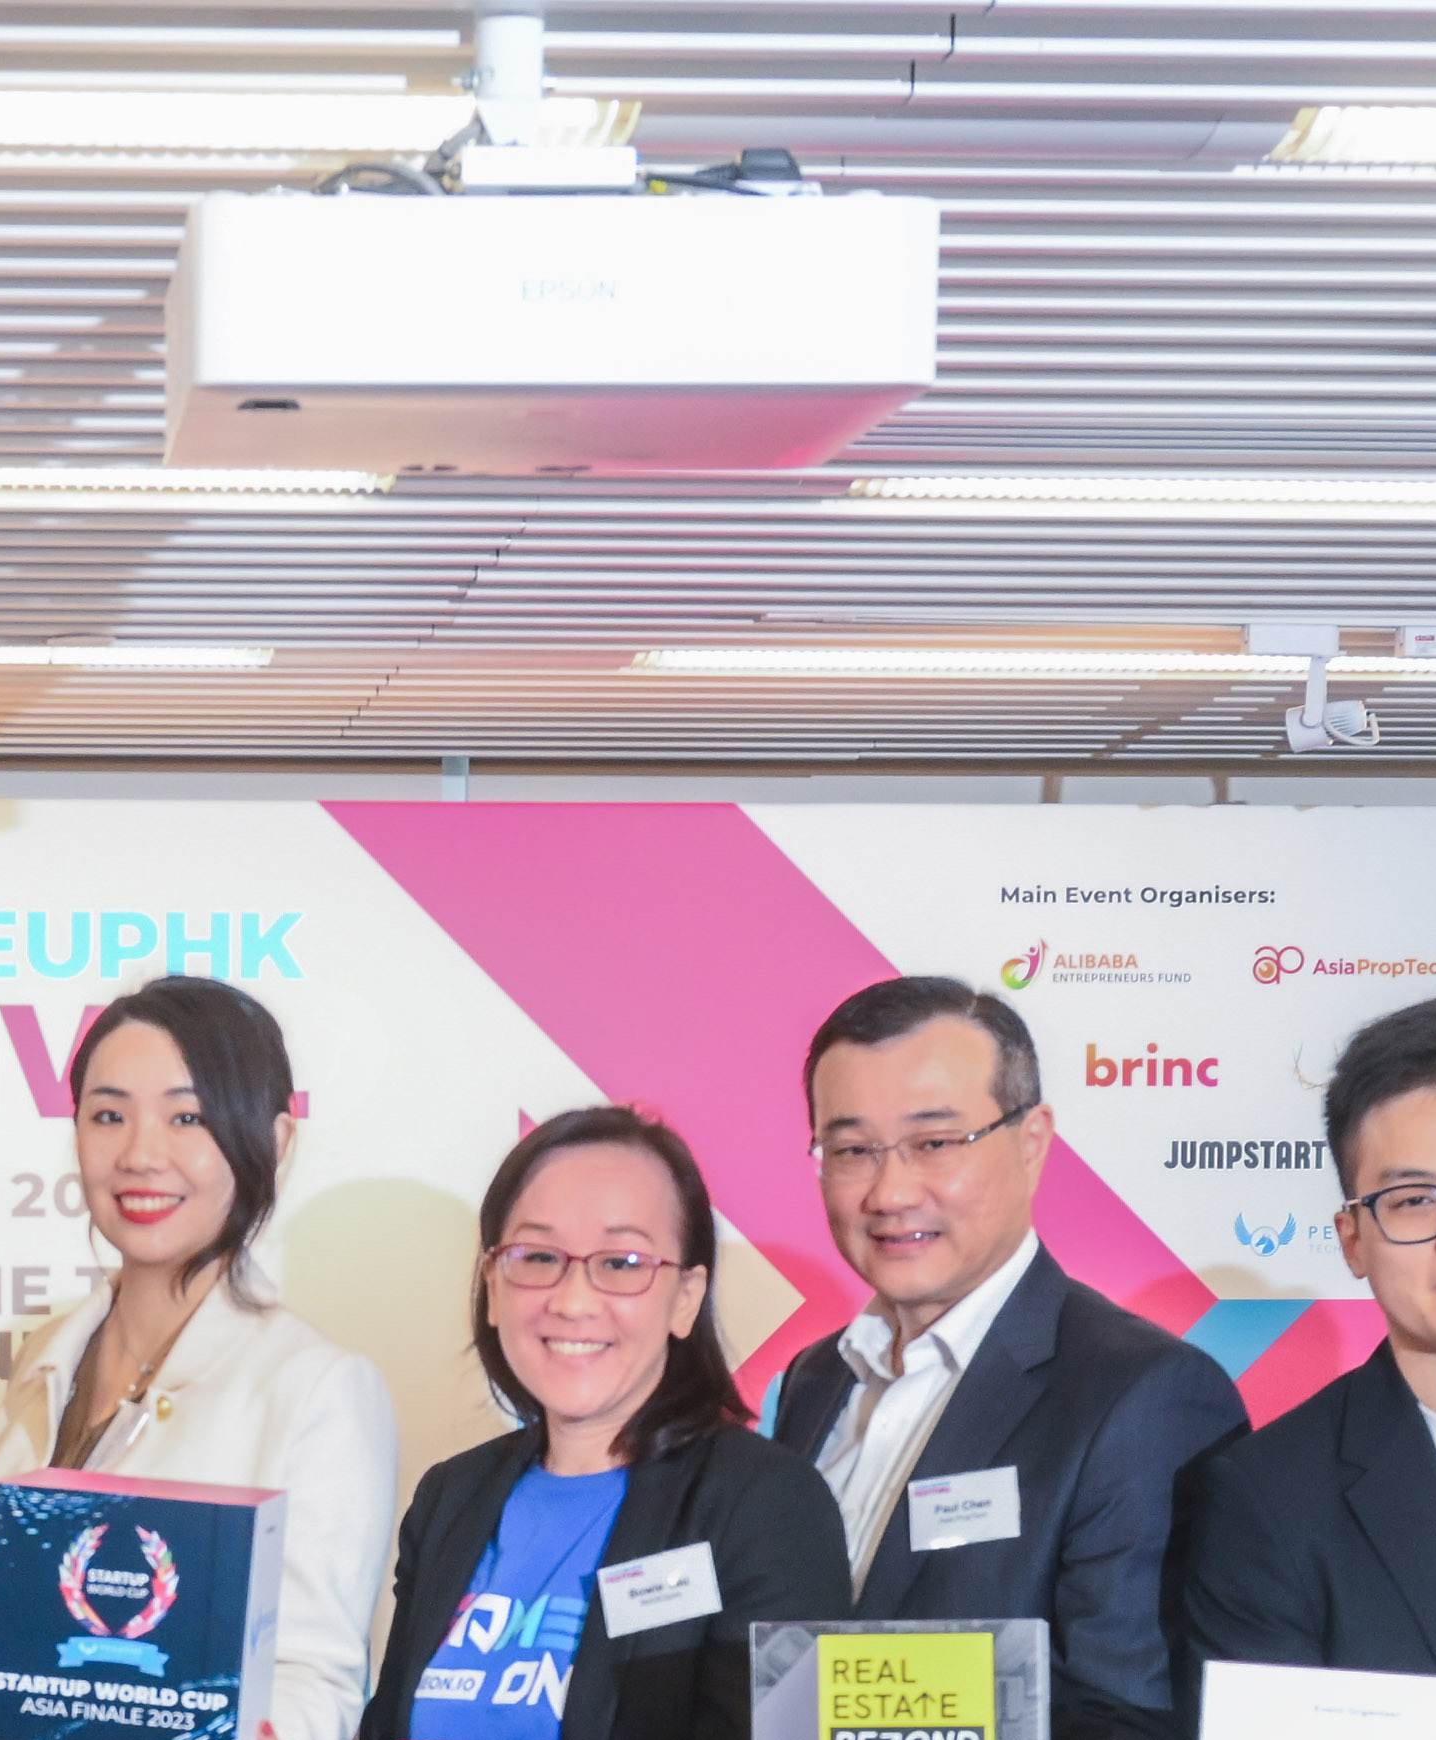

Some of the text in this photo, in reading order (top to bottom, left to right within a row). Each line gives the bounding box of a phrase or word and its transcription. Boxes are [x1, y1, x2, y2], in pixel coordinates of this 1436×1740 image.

[1001, 886, 1275, 908] Main Event Organisers:
[1053, 954, 1138, 969] ALIBABA
[1052, 973, 1192, 983] ENTREPRENEURS FUND
[1085, 1043, 1218, 1087] brinc
[1164, 1140, 1325, 1170] JUMPSTART
[832, 1659, 916, 1683] REAL
[94, 1681, 178, 1706] WORLD
[181, 1690, 228, 1711] CUP
[20, 1697, 195, 1731] ASIA FINALE 2023
